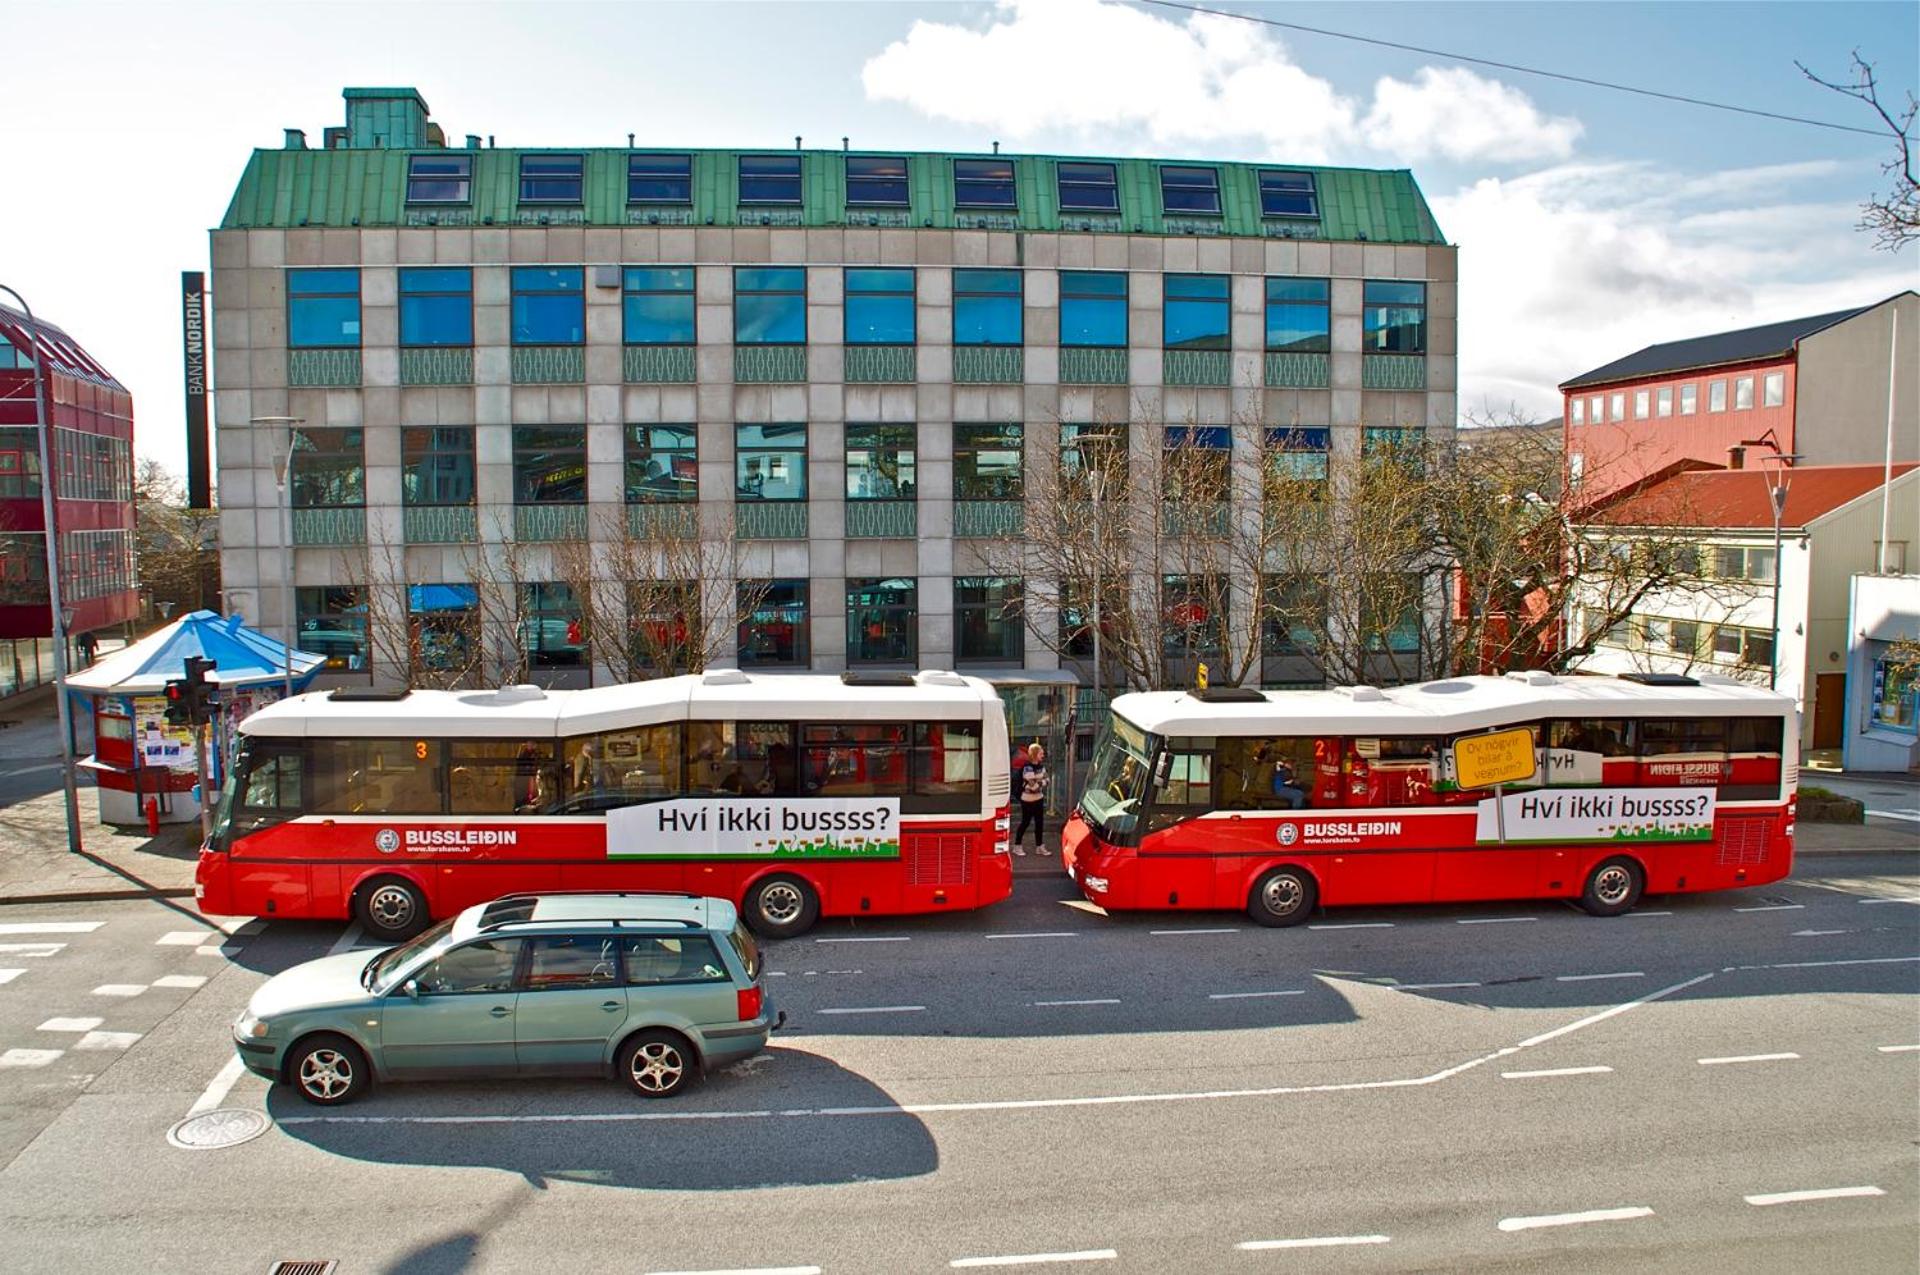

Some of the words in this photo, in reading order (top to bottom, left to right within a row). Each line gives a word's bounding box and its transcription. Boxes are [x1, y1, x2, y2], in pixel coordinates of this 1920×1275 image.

[416, 741, 427, 758] 3
[1315, 740, 1325, 756] 2
[1521, 795, 1562, 819] Hví
[1570, 796, 1613, 819] ikki
[1620, 795, 1708, 818] bussss?
[658, 807, 708, 832] Hví
[718, 807, 771, 832] ikki
[782, 807, 891, 832] bussss?
[1303, 822, 1402, 836] BUSSLEIÐIN
[405, 830, 517, 845] BUSSLEIÐIN
